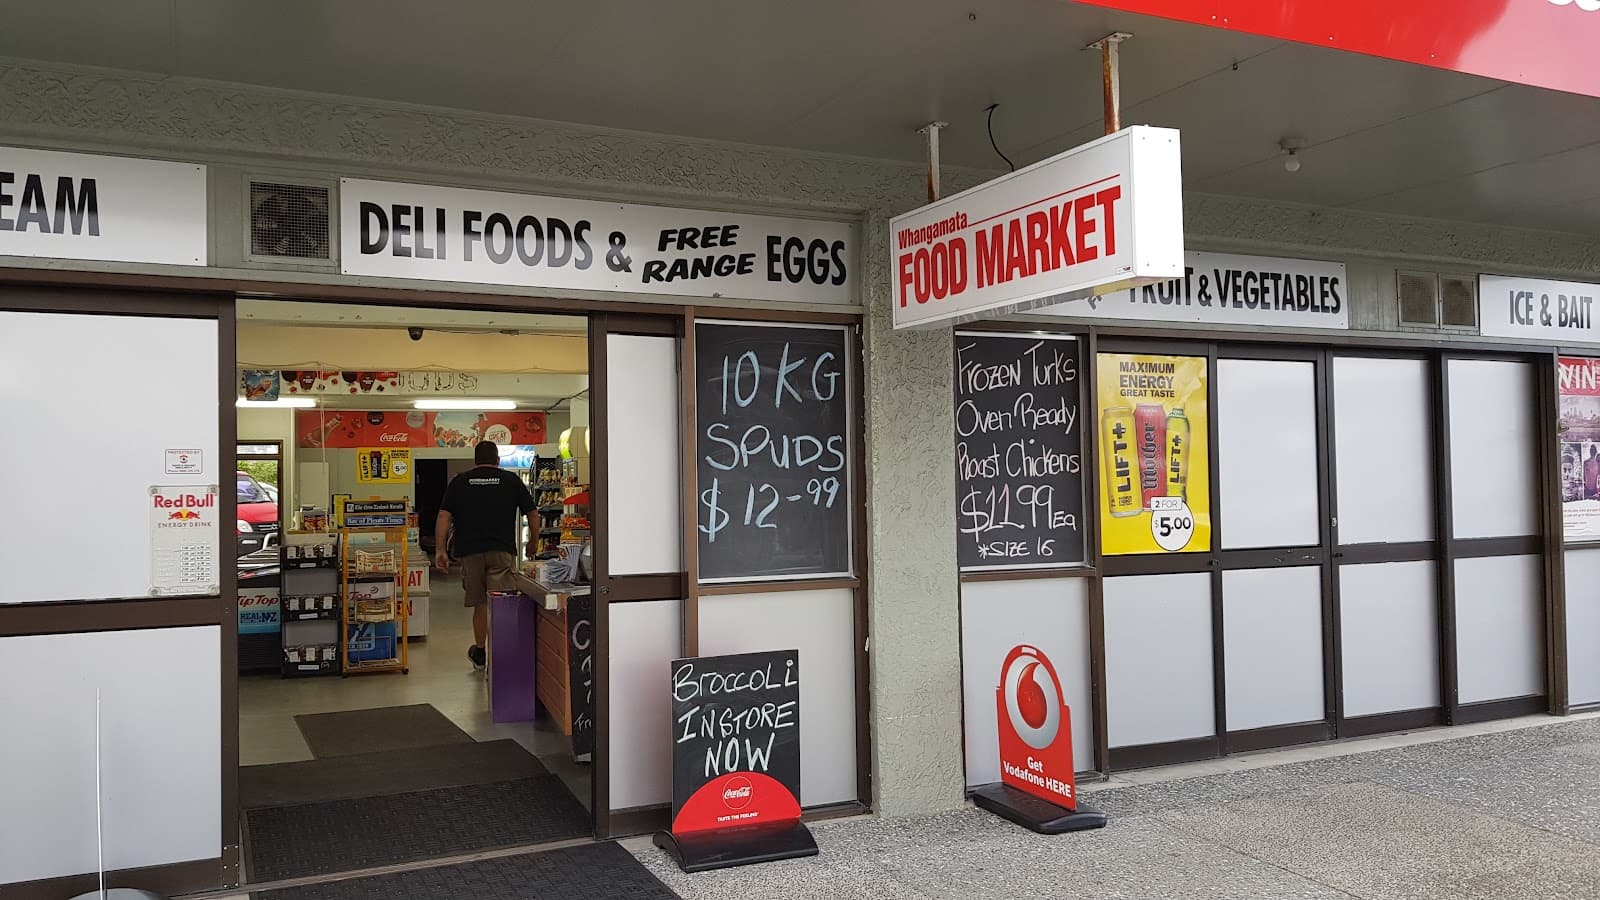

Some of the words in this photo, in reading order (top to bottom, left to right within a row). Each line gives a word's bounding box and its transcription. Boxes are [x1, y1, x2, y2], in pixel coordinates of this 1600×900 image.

[359, 200, 446, 261] DELI
[463, 210, 594, 271] FOODS
[605, 230, 633, 273] &
[658, 224, 740, 252] FREE
[898, 210, 969, 250] Whangamata
[898, 237, 968, 309] FOOD
[975, 184, 1122, 289] MARKET
[642, 252, 756, 285] RANGE
[766, 234, 847, 286] EGGS
[1197, 274, 1213, 307] &
[1217, 268, 1342, 315] VEGETABLES
[1509, 289, 1534, 326] ICE
[1539, 292, 1553, 328] &
[1558, 295, 1593, 330] BAIT
[722, 350, 761, 416] 10
[1119, 361, 1175, 374] MAXIMUM
[1119, 374, 1175, 389] ENERGY
[1120, 389, 1147, 398] GREAT
[1150, 389, 1175, 398] TASTE
[956, 399, 1013, 437] Oven
[1013, 392, 1077, 435] Ready
[704, 423, 845, 473] SPUDS
[957, 441, 1001, 481] Roast
[1112, 422, 1132, 493] LIFT+
[1169, 434, 1183, 484] LIFT+
[154, 493, 183, 508] Red
[186, 493, 214, 508] Bull
[1154, 500, 1161, 509] 2
[1162, 500, 1178, 509] FOR
[255, 594, 279, 607] Top
[704, 731, 776, 778] NOW
[1027, 756, 1043, 774] Get
[1002, 760, 1045, 788] Vodafone
[1045, 776, 1072, 798] HERE
